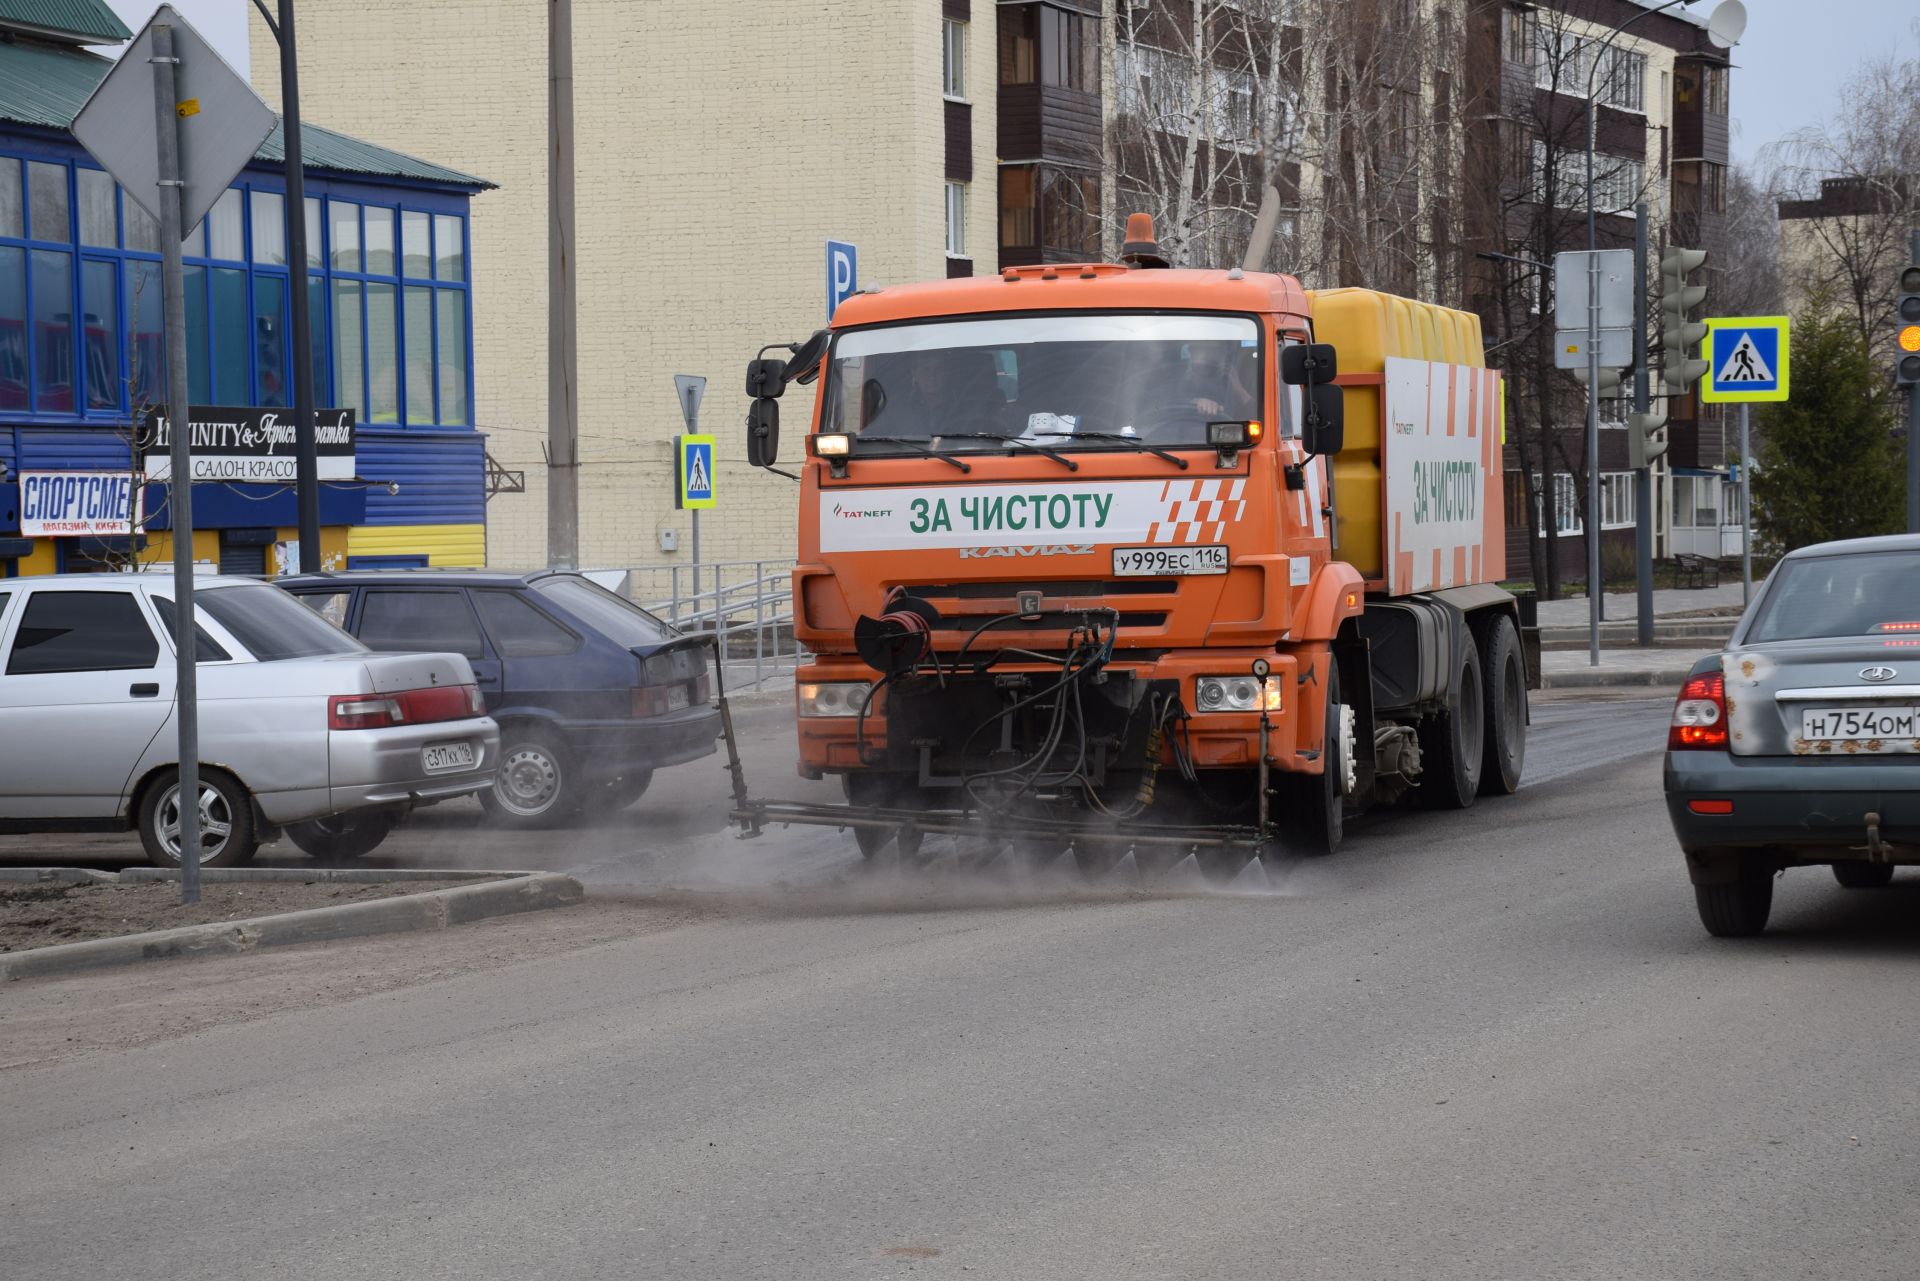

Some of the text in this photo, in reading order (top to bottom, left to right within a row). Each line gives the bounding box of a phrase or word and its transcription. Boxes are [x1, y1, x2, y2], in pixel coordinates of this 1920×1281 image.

[834, 250, 851, 309] P
[156, 417, 247, 447] IINITY
[1395, 423, 1414, 435] TATNEFT
[195, 460, 297, 477] САЛОН КРАСО
[1414, 460, 1476, 525] ЗА ЧИСТОТУ
[843, 510, 893, 518] TATNEFT
[909, 493, 1113, 533] ЗА ЧИСТОТУ
[43, 521, 87, 532] МАГАЗИН
[960, 544, 1095, 559] KAMAZ
[1195, 549, 1222, 563] 116
